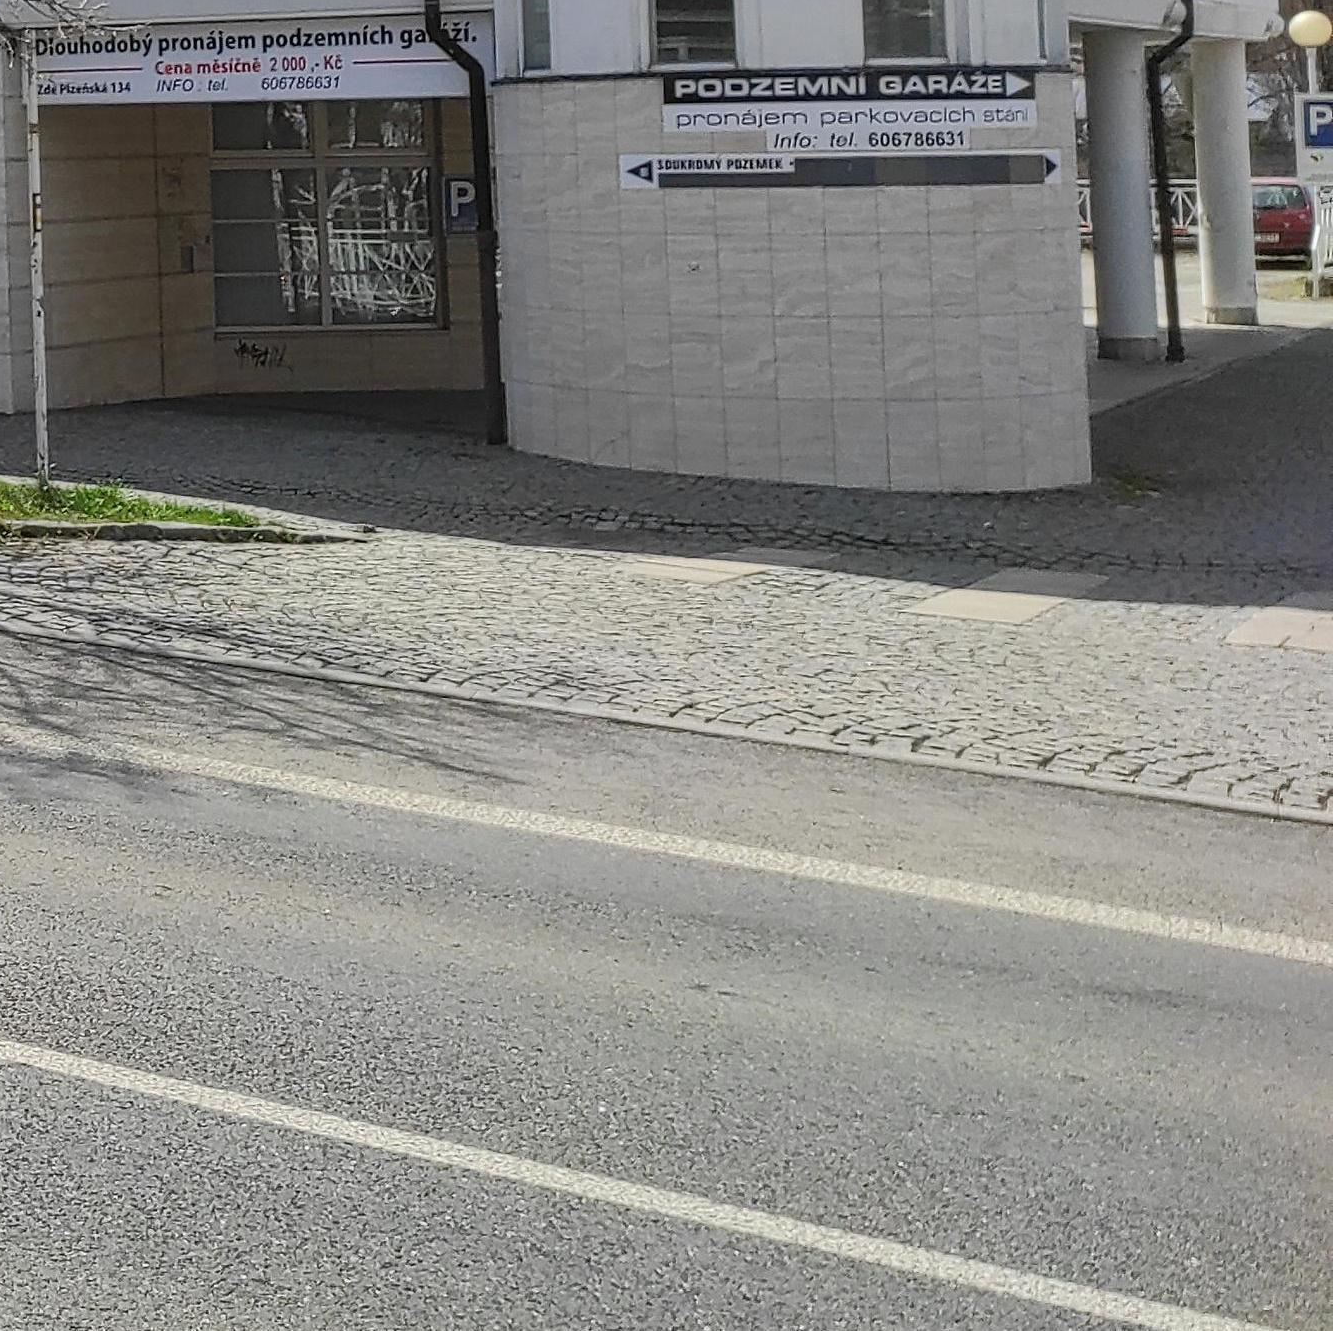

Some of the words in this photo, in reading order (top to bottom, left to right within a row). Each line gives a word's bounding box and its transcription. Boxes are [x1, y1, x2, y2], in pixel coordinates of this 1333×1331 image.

[35, 33, 153, 57] Dlouhodobý
[158, 30, 257, 55] pronájem
[262, 24, 393, 53] podzemních
[155, 61, 193, 75] Cena
[197, 57, 261, 74] měsíčně
[269, 57, 278, 72] 2
[282, 56, 306, 71] 000
[324, 54, 343, 71] Kč
[112, 81, 131, 93] 134
[156, 79, 194, 92] INFO
[208, 78, 229, 91] tel.
[261, 76, 340, 90] 606786631
[675, 73, 867, 98] PODZEMNÍ
[879, 71, 1003, 95] GARÁŽE
[677, 109, 808, 129] pronájem
[774, 133, 818, 149] Info:
[868, 130, 965, 148] 606786631
[726, 158, 783, 170] POZEMEK
[450, 181, 475, 217] P
